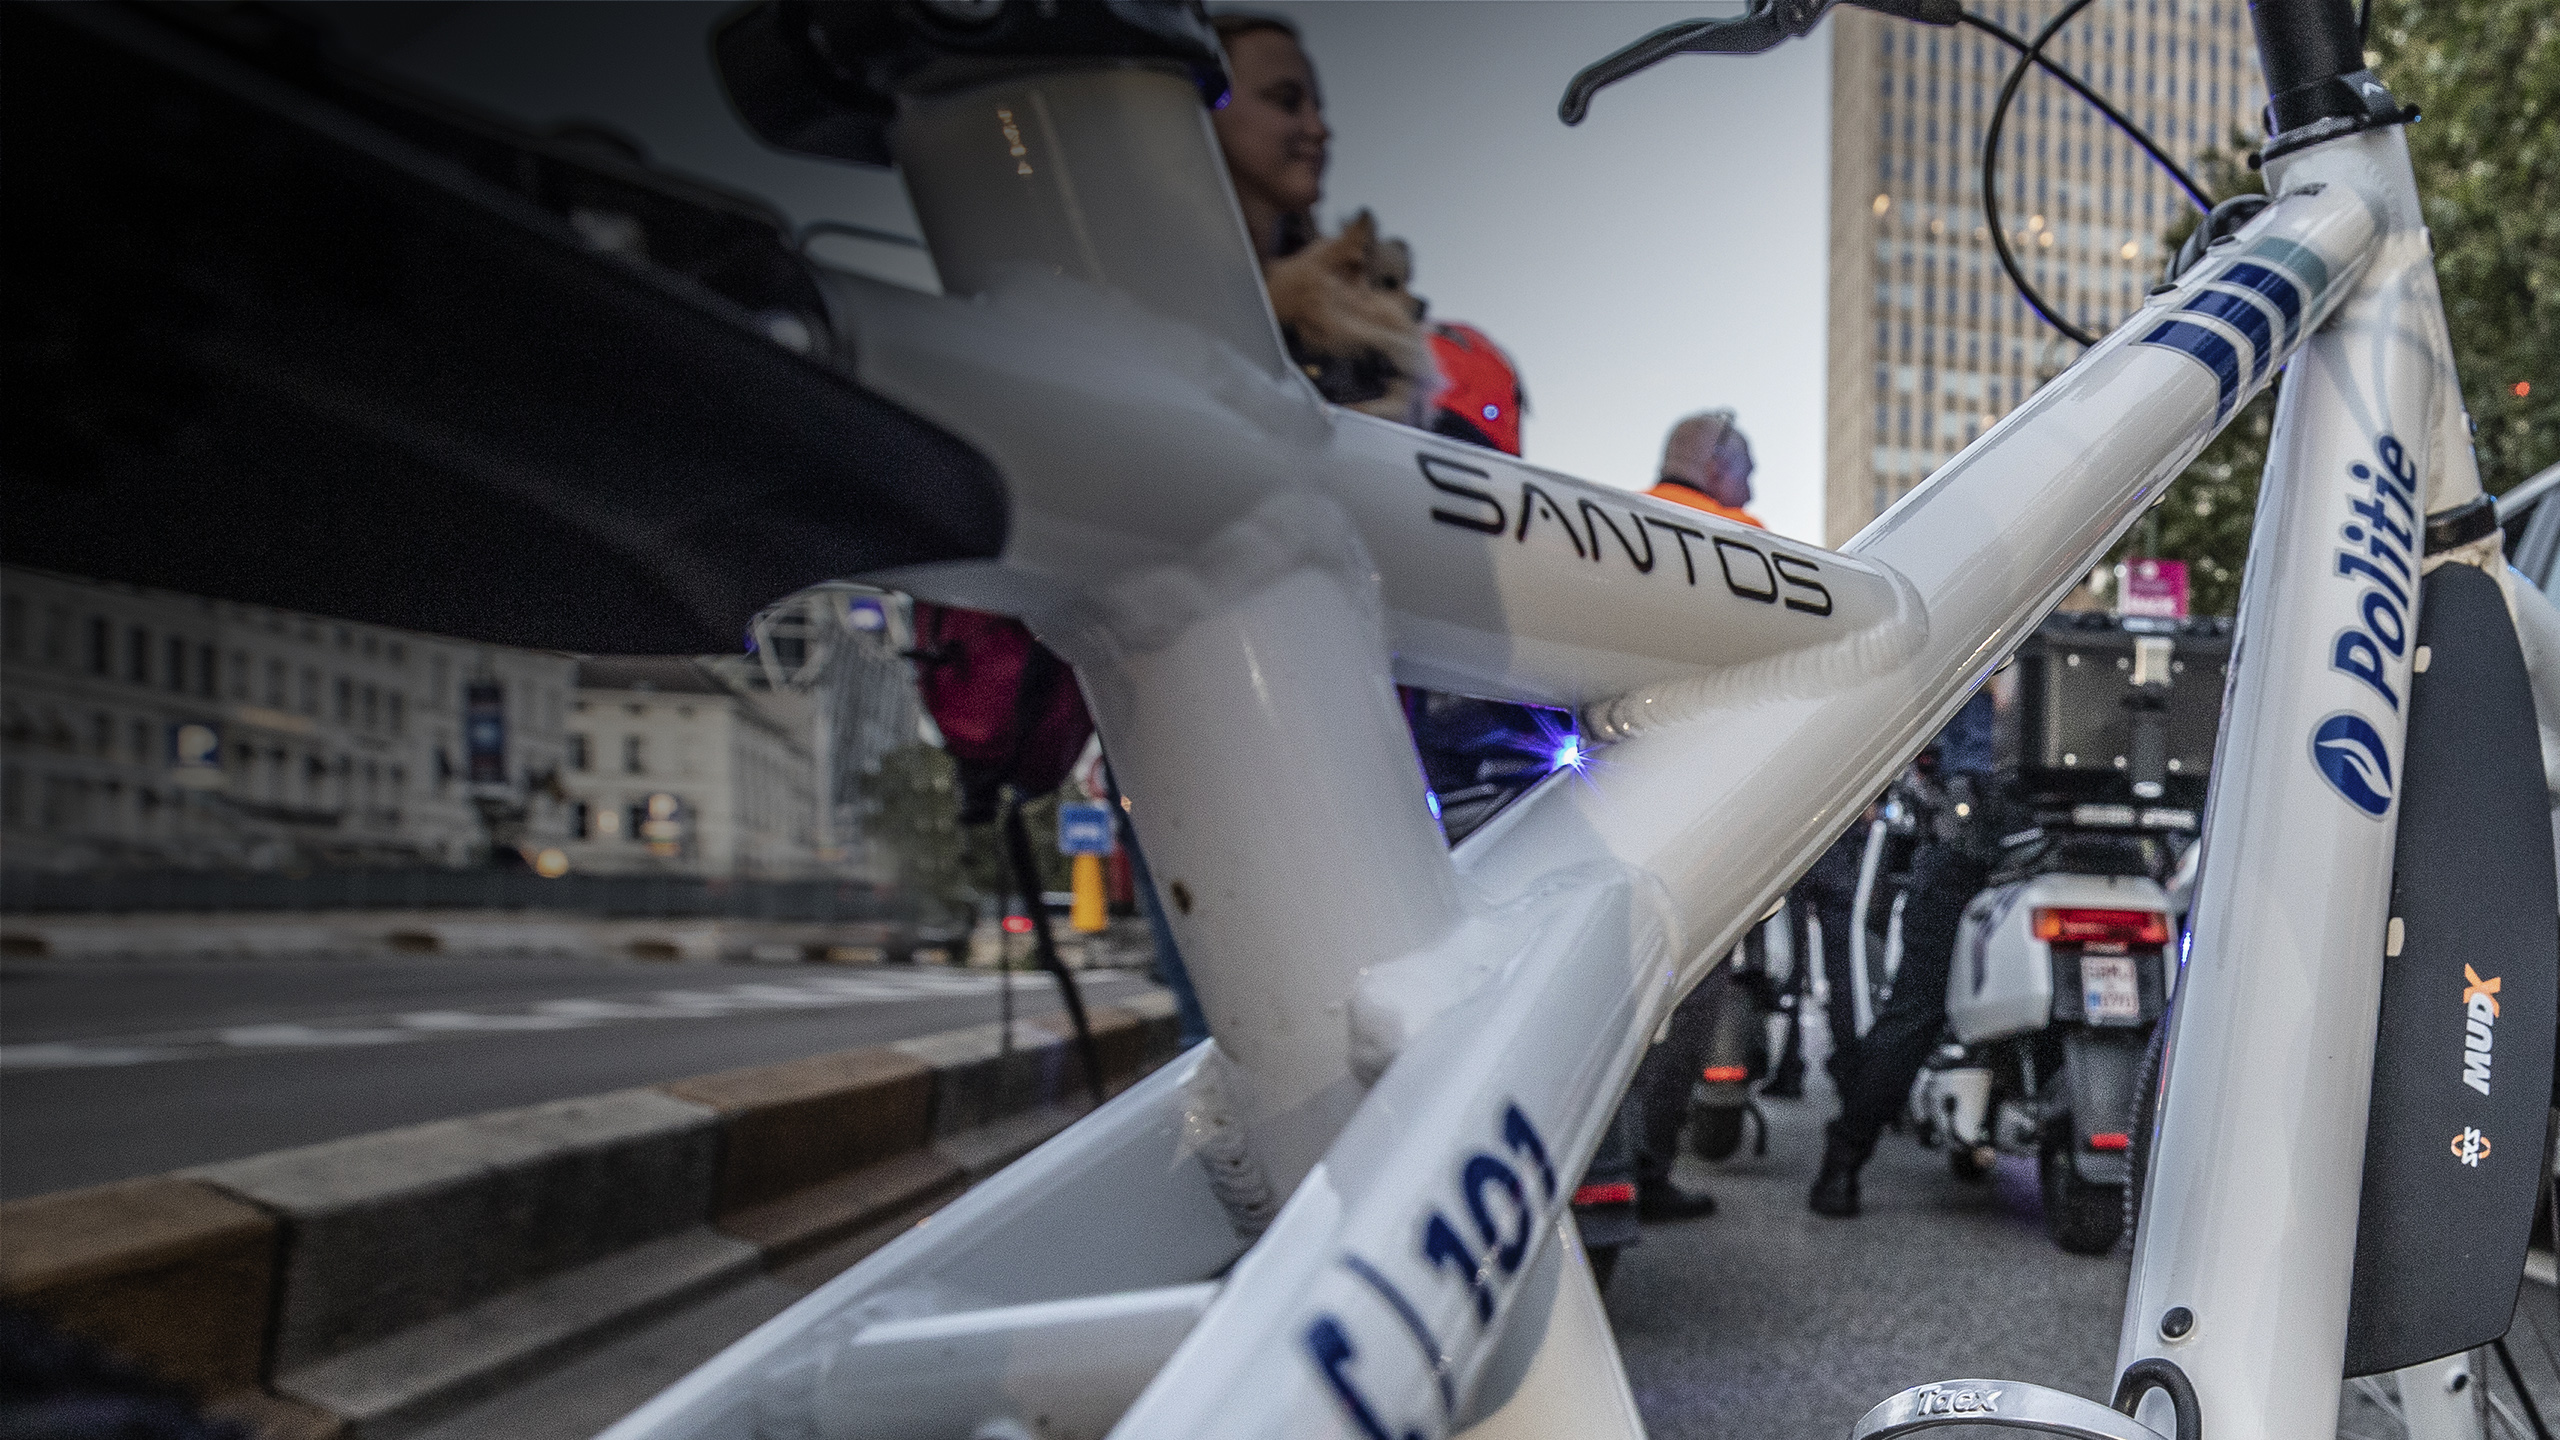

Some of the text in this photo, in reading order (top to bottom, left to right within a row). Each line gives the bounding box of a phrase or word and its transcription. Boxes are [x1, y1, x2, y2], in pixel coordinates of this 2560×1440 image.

[1417, 452, 1833, 617] SANTOS
[2335, 435, 2416, 711] Politie
[2463, 963, 2501, 1096] MUDX
[1423, 1101, 1557, 1327] 101
[2461, 1126, 2481, 1168] SKS
